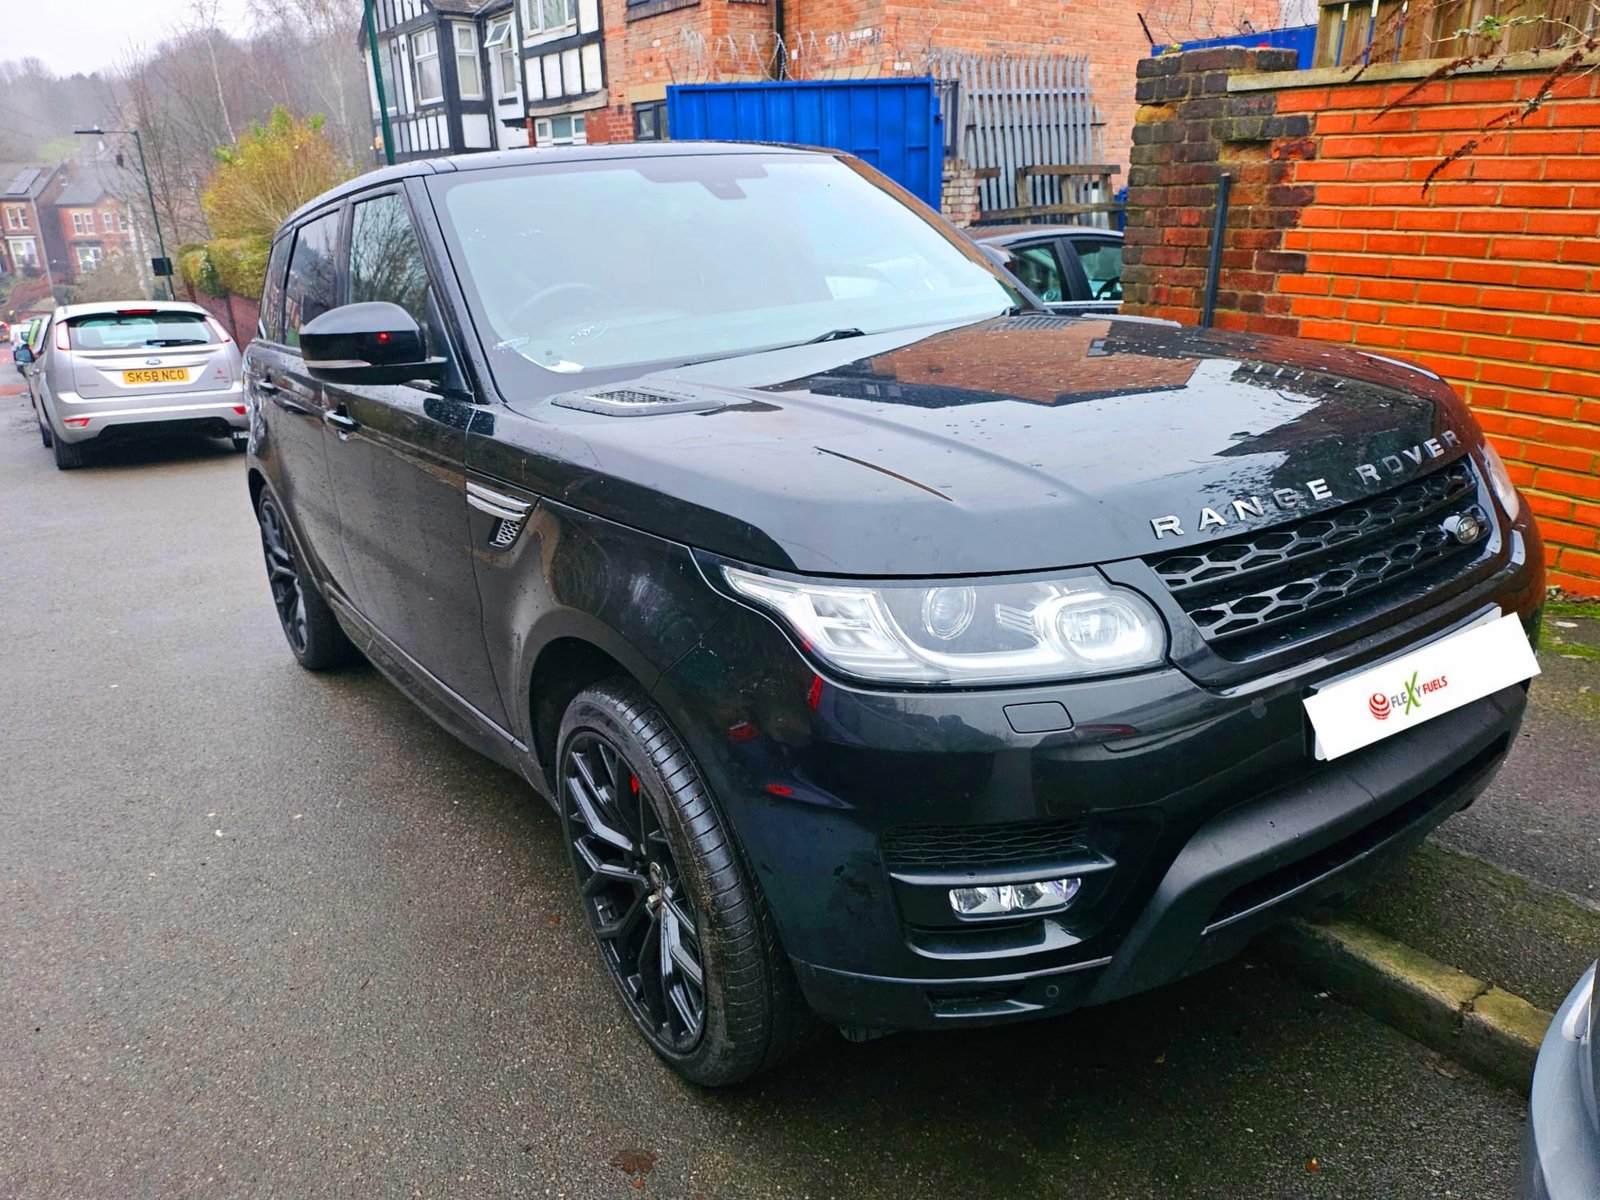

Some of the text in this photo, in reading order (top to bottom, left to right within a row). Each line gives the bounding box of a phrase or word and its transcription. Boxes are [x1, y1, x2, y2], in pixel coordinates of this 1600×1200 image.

[127, 370, 185, 383] SK58 NCO
[1151, 430, 1464, 540] RANGE ROVER
